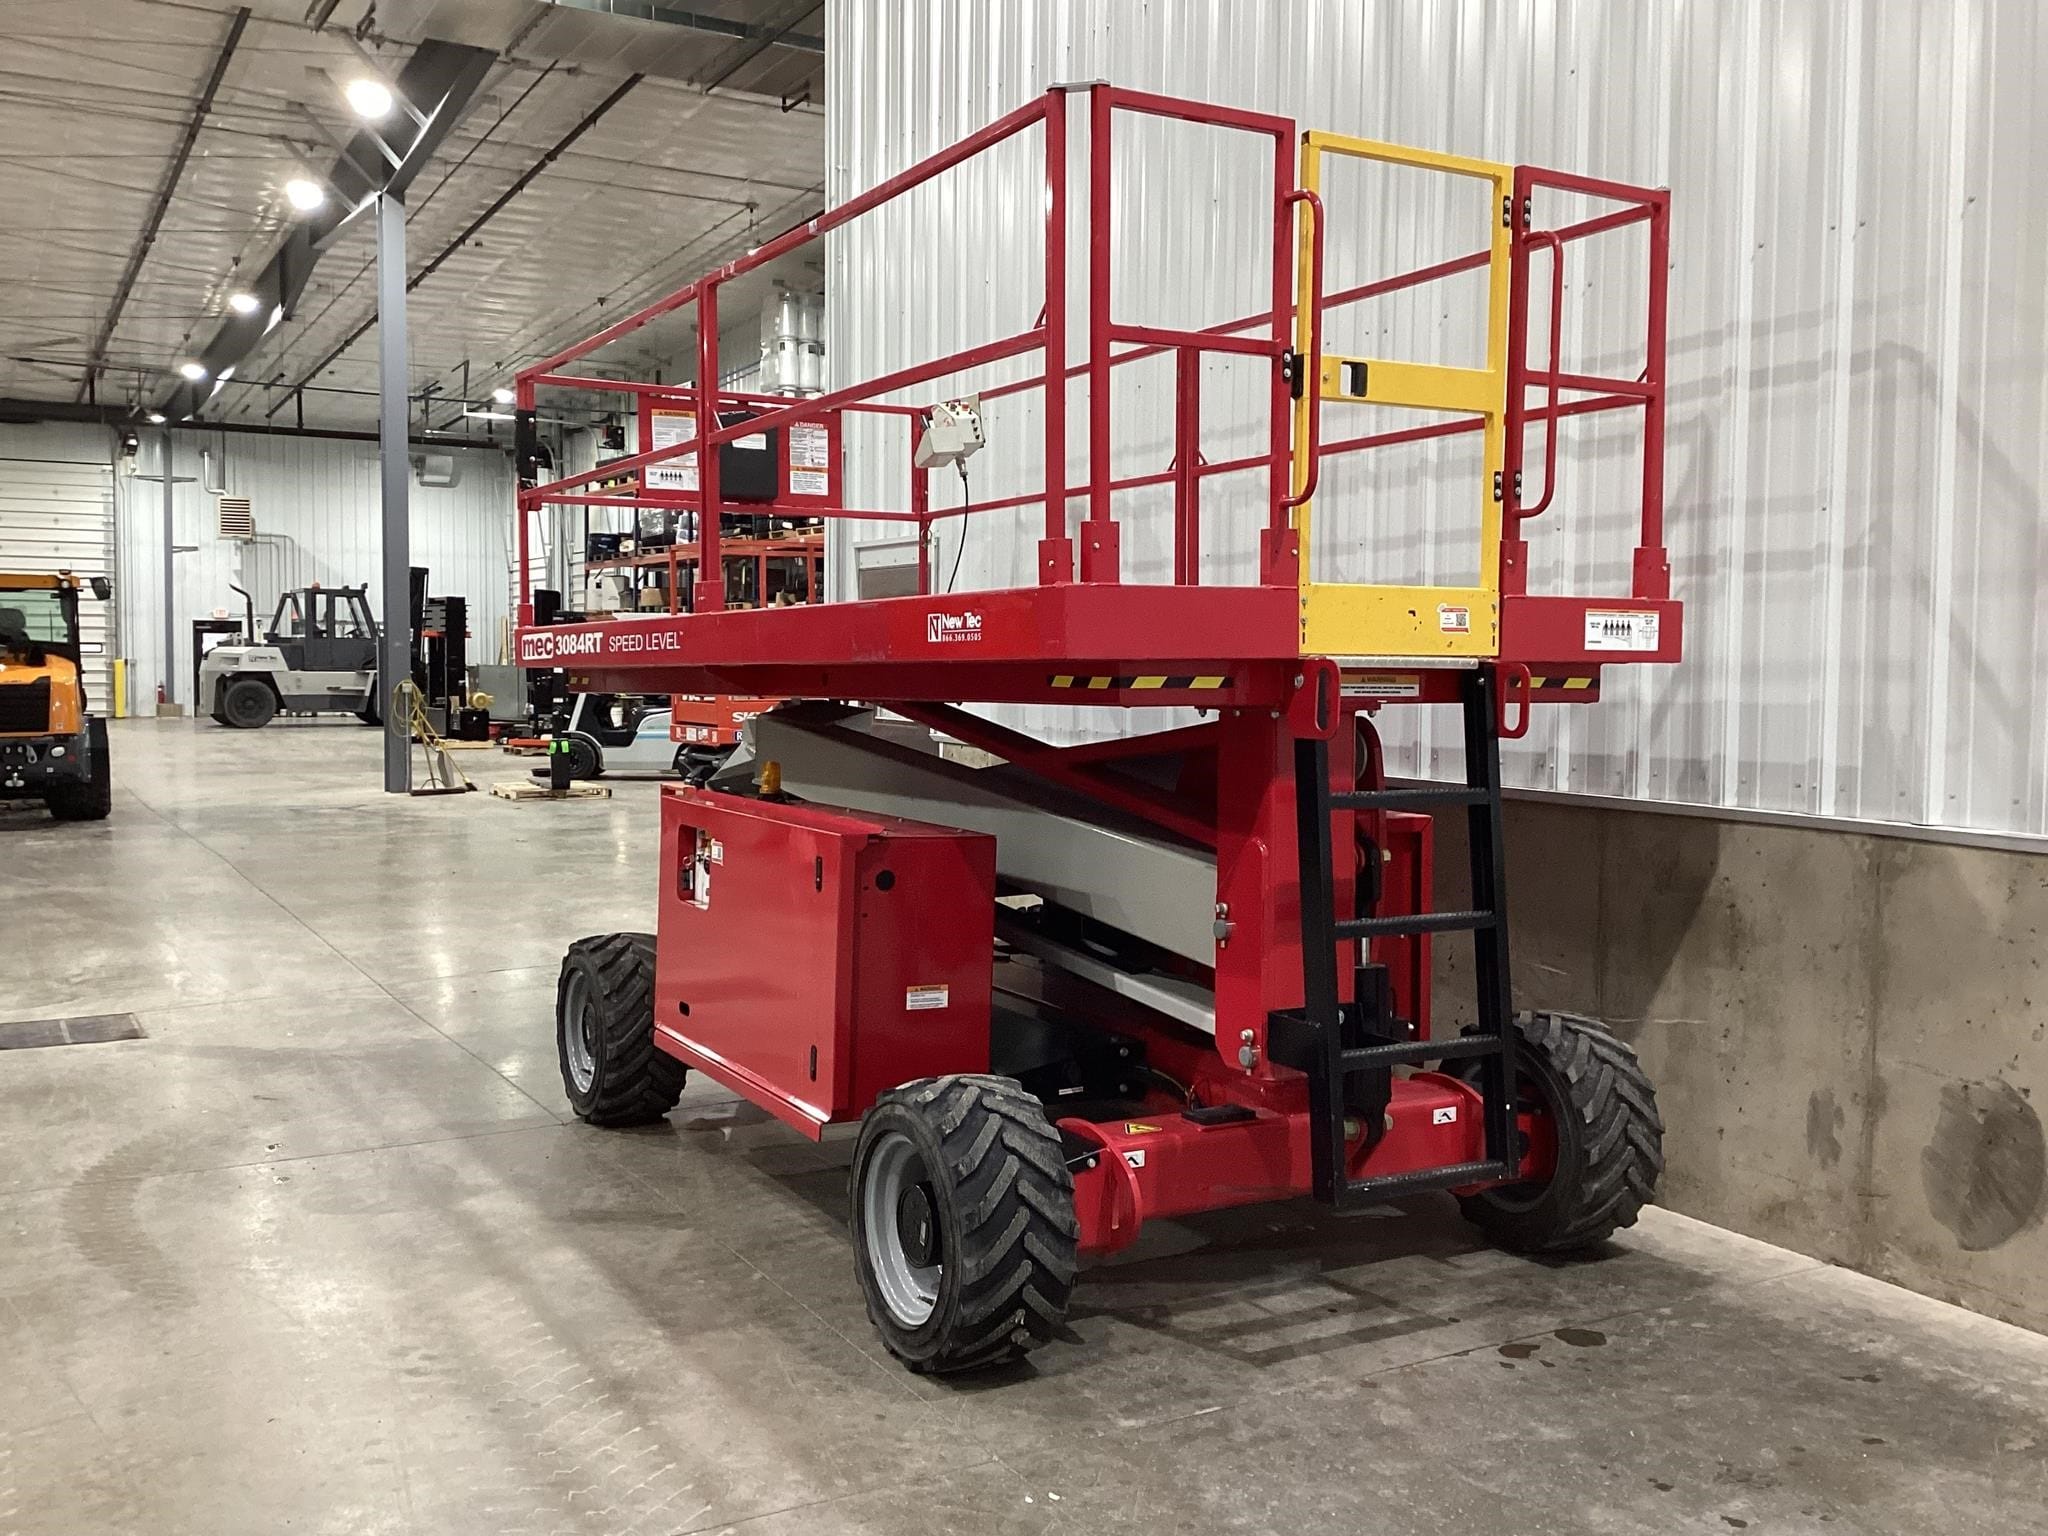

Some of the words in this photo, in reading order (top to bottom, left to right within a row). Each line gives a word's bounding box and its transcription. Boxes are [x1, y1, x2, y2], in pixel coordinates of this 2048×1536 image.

[942, 613, 963, 629] New
[964, 611, 982, 629] Tec
[523, 635, 554, 658] mec
[555, 632, 604, 656] 3084RT
[608, 634, 643, 653] SPEED
